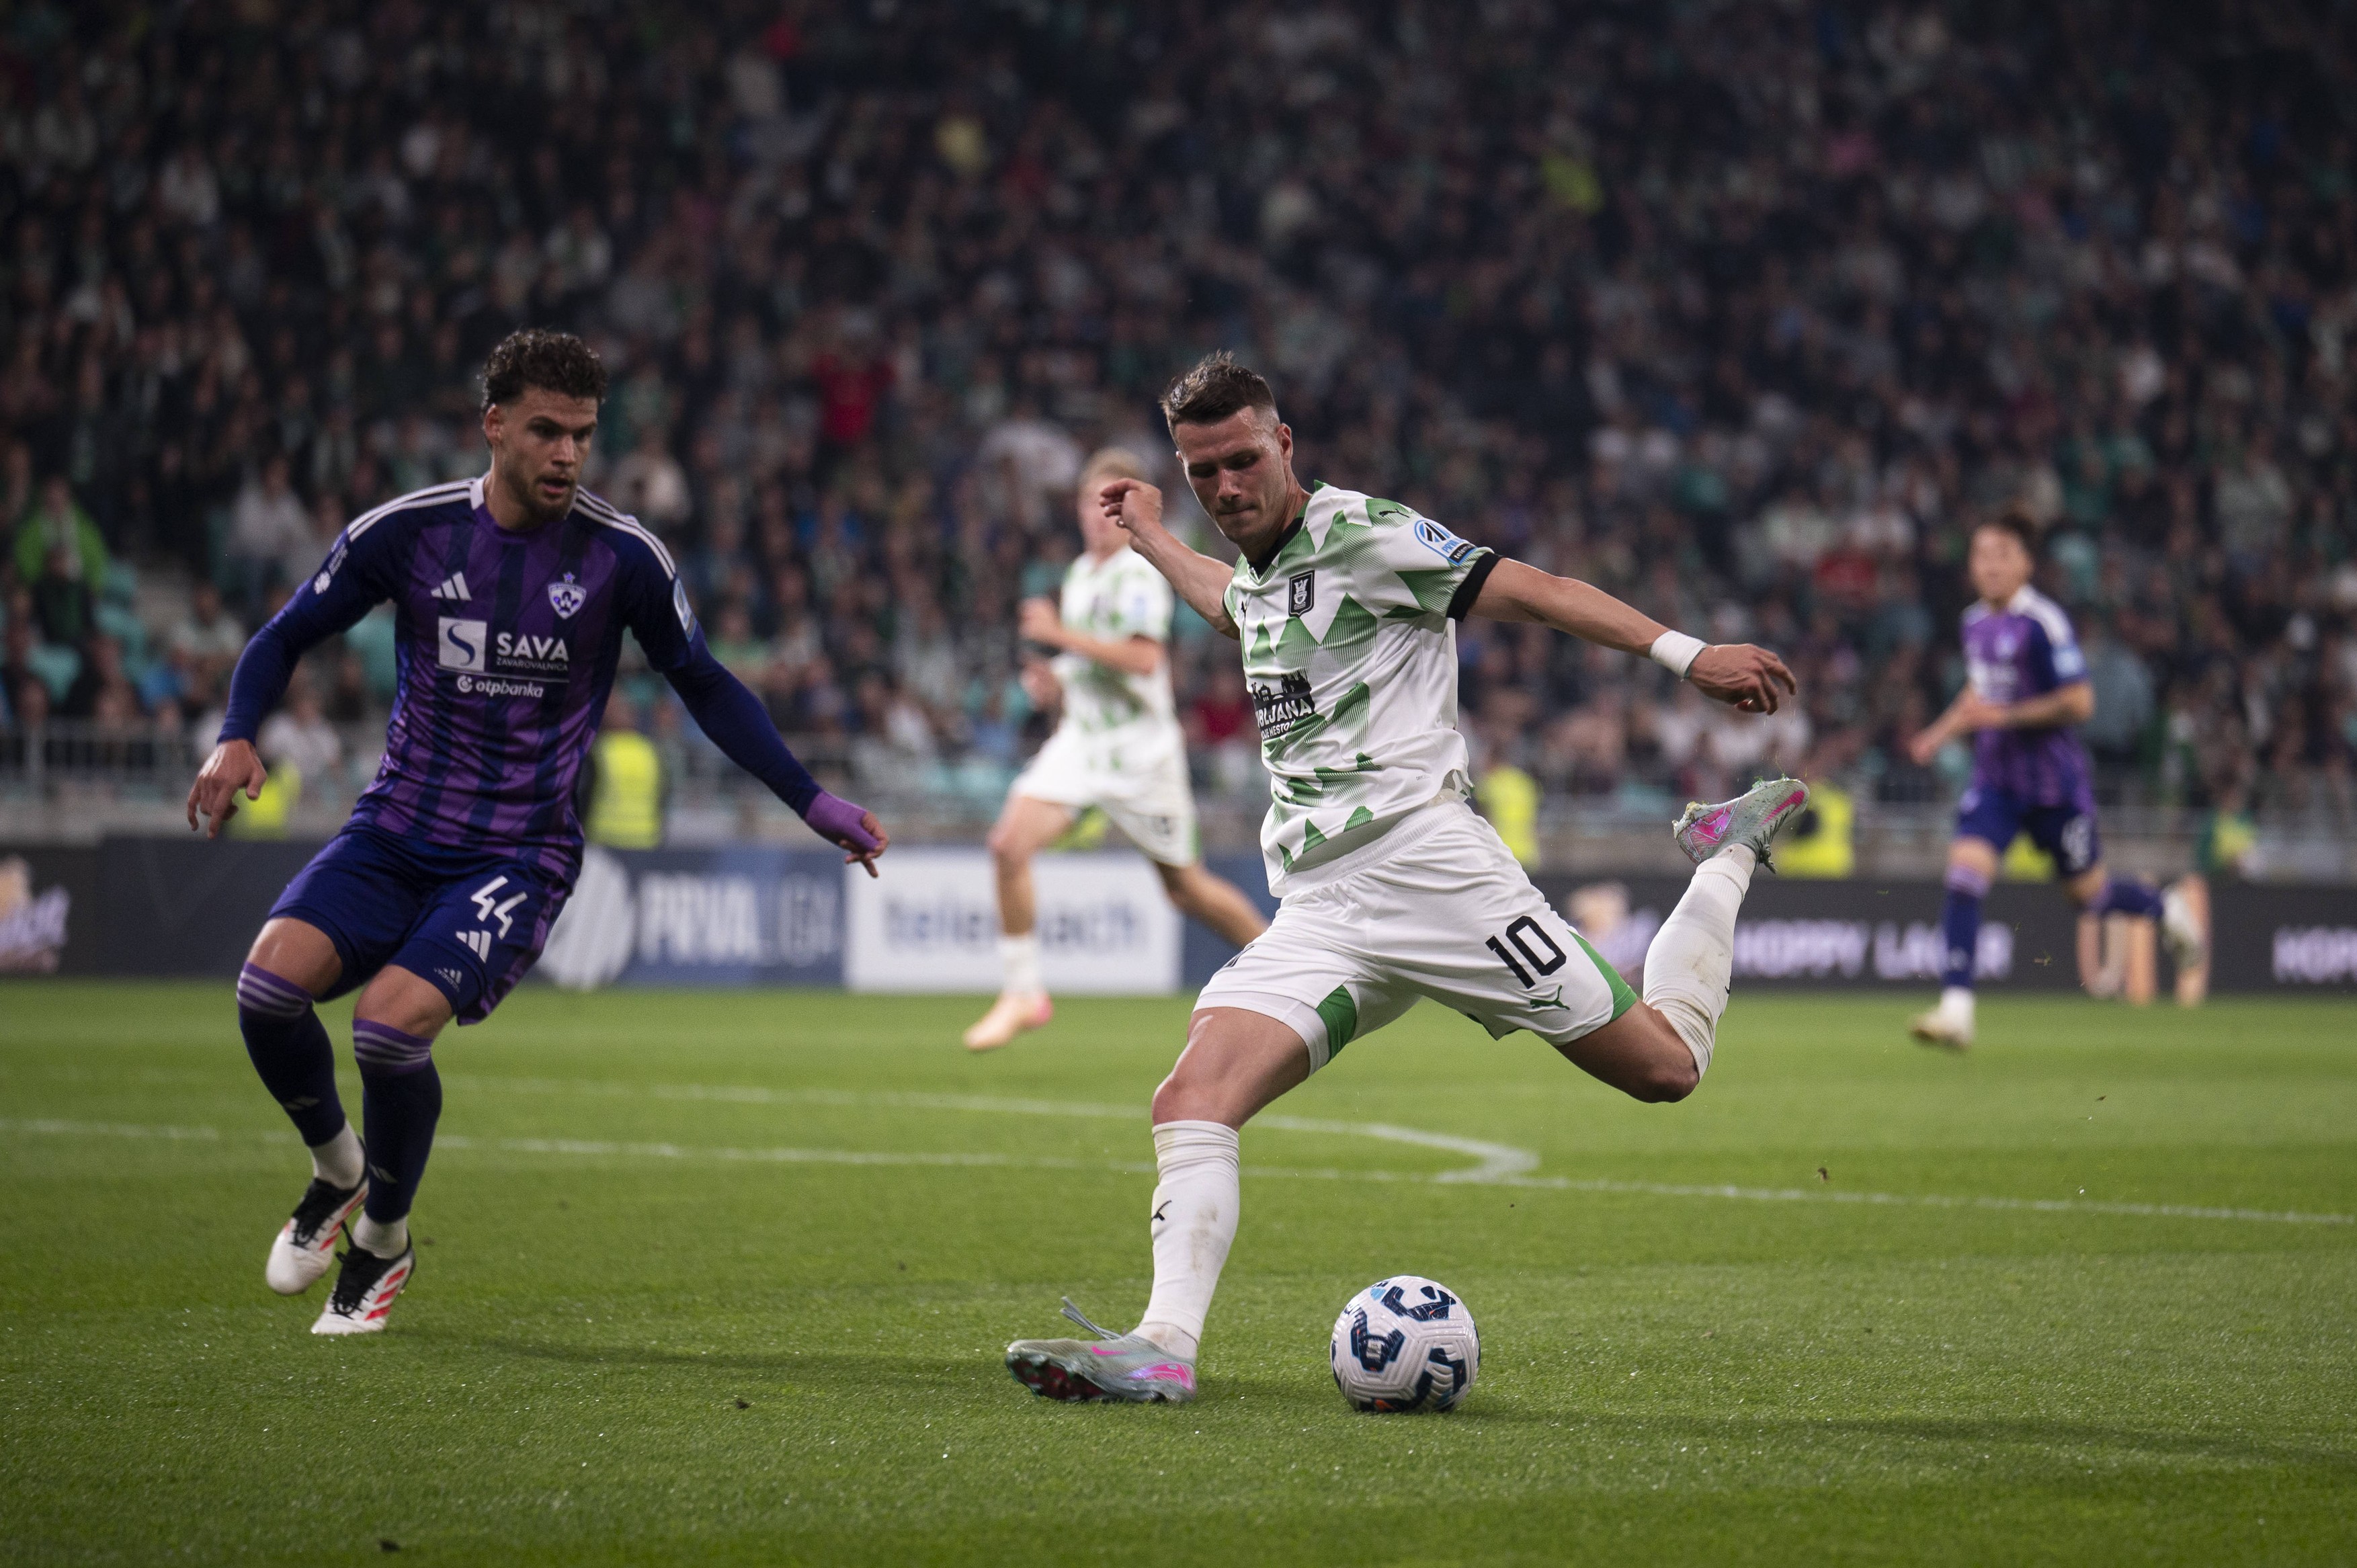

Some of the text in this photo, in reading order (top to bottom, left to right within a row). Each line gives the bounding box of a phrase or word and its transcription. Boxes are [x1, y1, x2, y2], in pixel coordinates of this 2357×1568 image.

[1441, 539, 1459, 554] PRVA
[496, 632, 570, 662] SAVA
[496, 656, 569, 671] ZAVAROVALNICA
[475, 680, 544, 698] otpbanka
[470, 875, 528, 940] 44
[1485, 918, 1567, 990] 10
